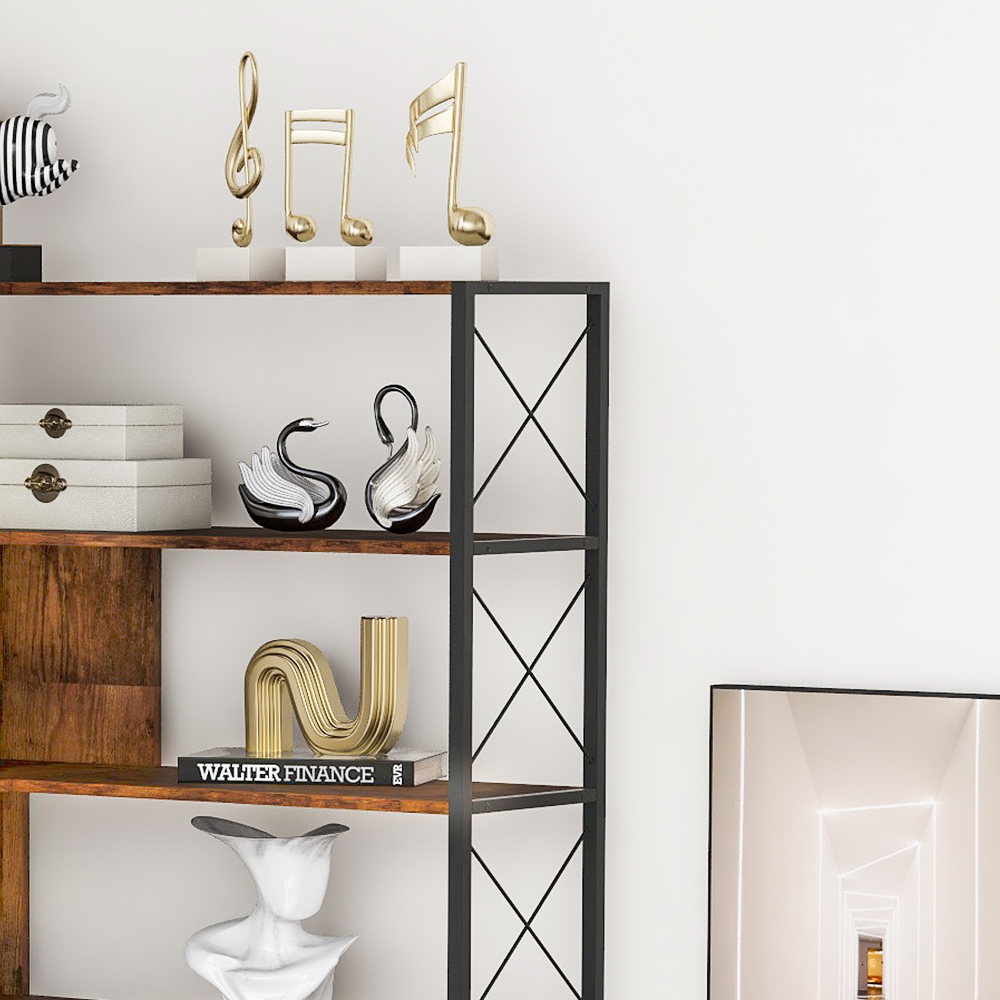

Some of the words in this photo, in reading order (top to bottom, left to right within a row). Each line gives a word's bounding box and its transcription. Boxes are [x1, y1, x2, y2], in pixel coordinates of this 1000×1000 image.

[197, 763, 282, 783] WALTER
[283, 765, 375, 784] FINANCE
[392, 763, 403, 786] EVR
